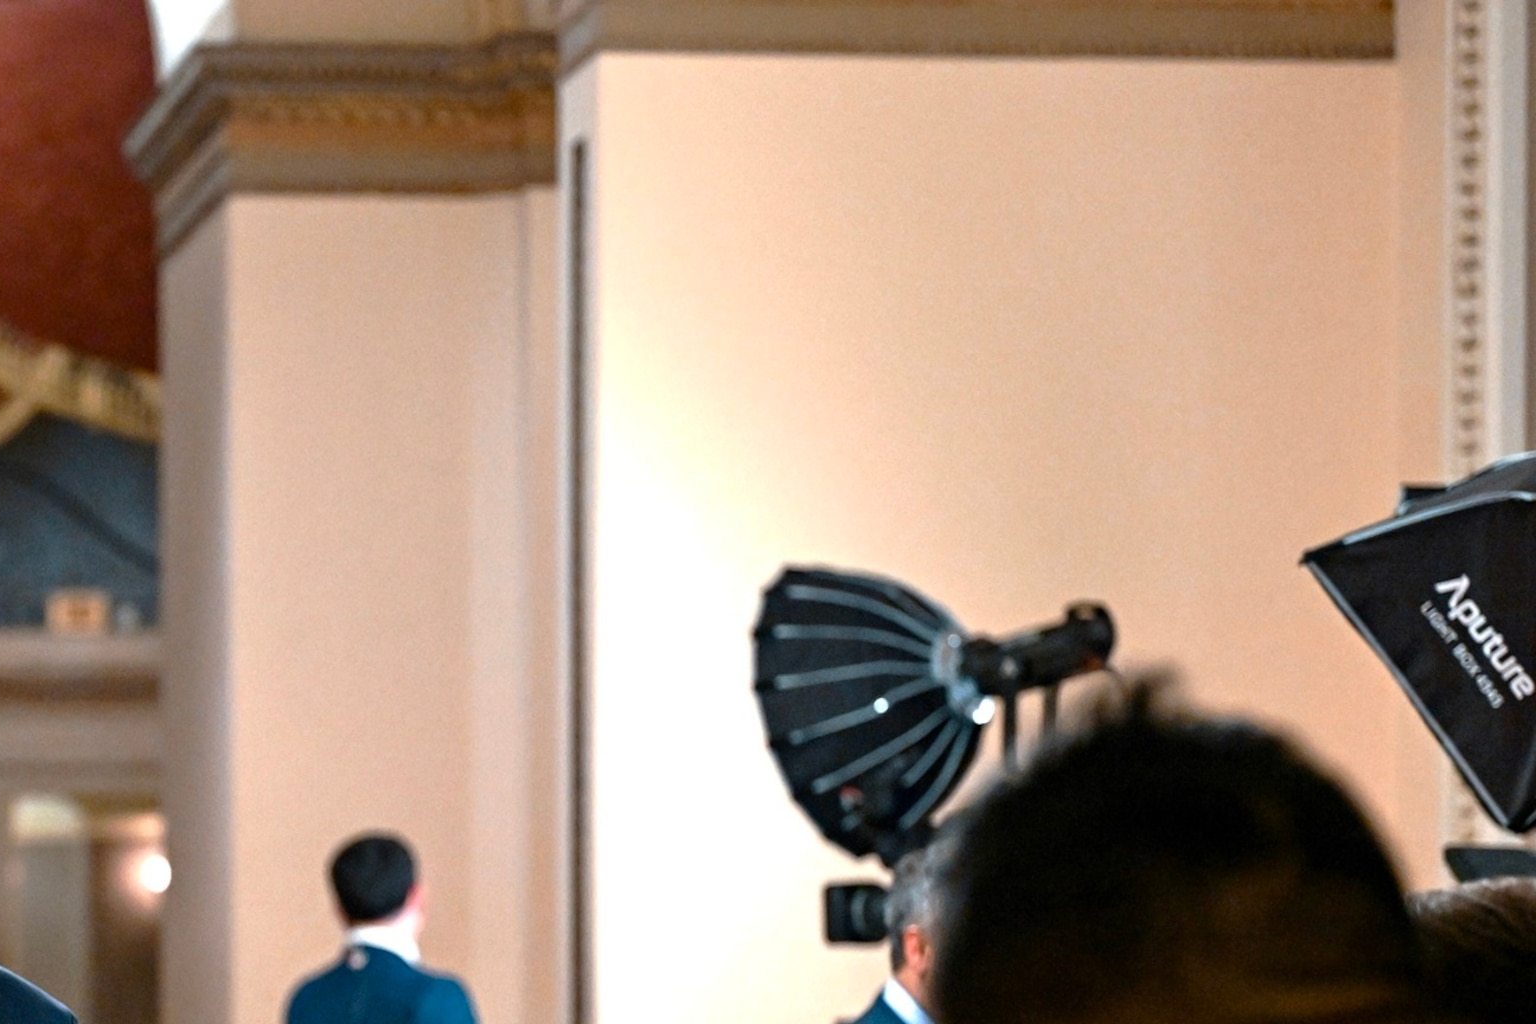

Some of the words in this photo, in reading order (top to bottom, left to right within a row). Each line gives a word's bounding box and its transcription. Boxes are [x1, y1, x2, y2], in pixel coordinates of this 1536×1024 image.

[1421, 601, 1458, 644] LIGHT
[1453, 644, 1481, 677] BOX
[1435, 574, 1535, 700] Aputure
